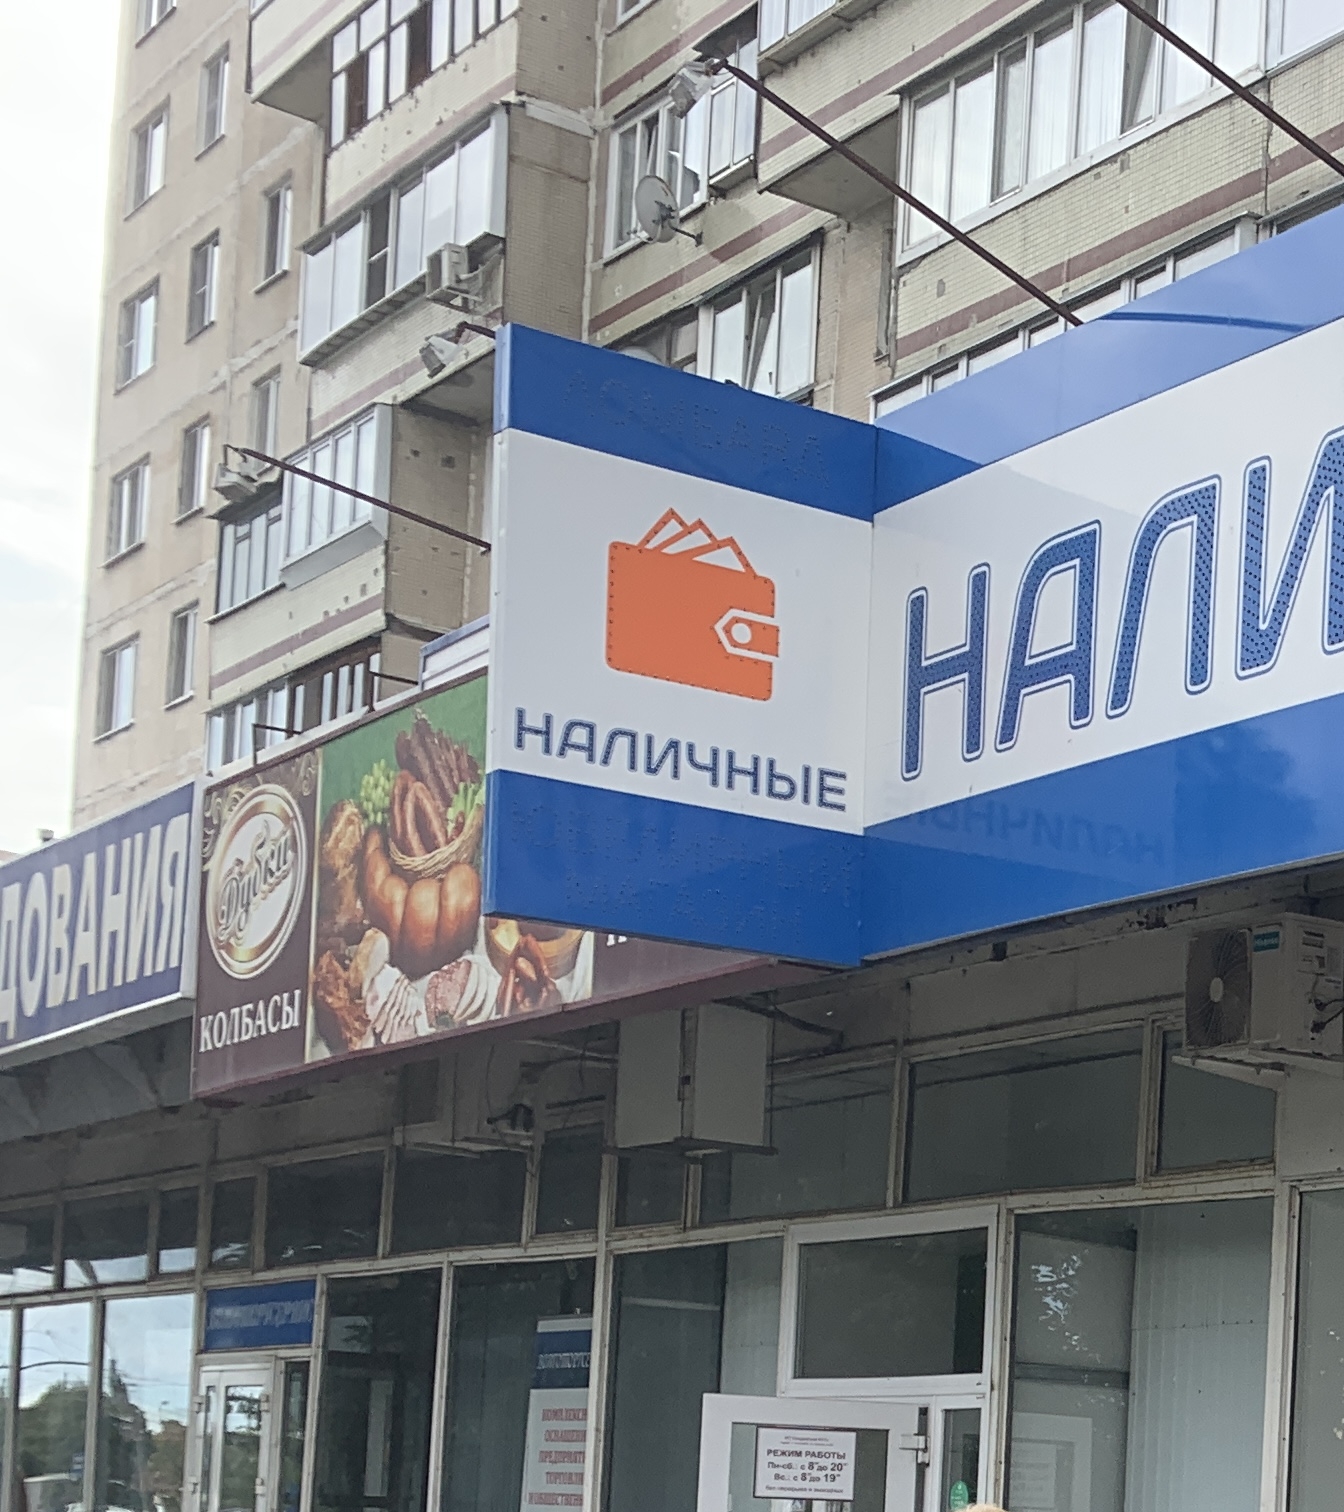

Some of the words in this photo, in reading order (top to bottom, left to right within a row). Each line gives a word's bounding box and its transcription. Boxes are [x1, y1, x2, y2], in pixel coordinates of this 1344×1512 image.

[515, 705, 850, 812] НАЛИЧНЫЕ
[200, 989, 301, 1052] КОЛБАСЫ
[767, 1449, 802, 1458] РЕЖИМ
[805, 1450, 846, 1460] РАБОТЫ
